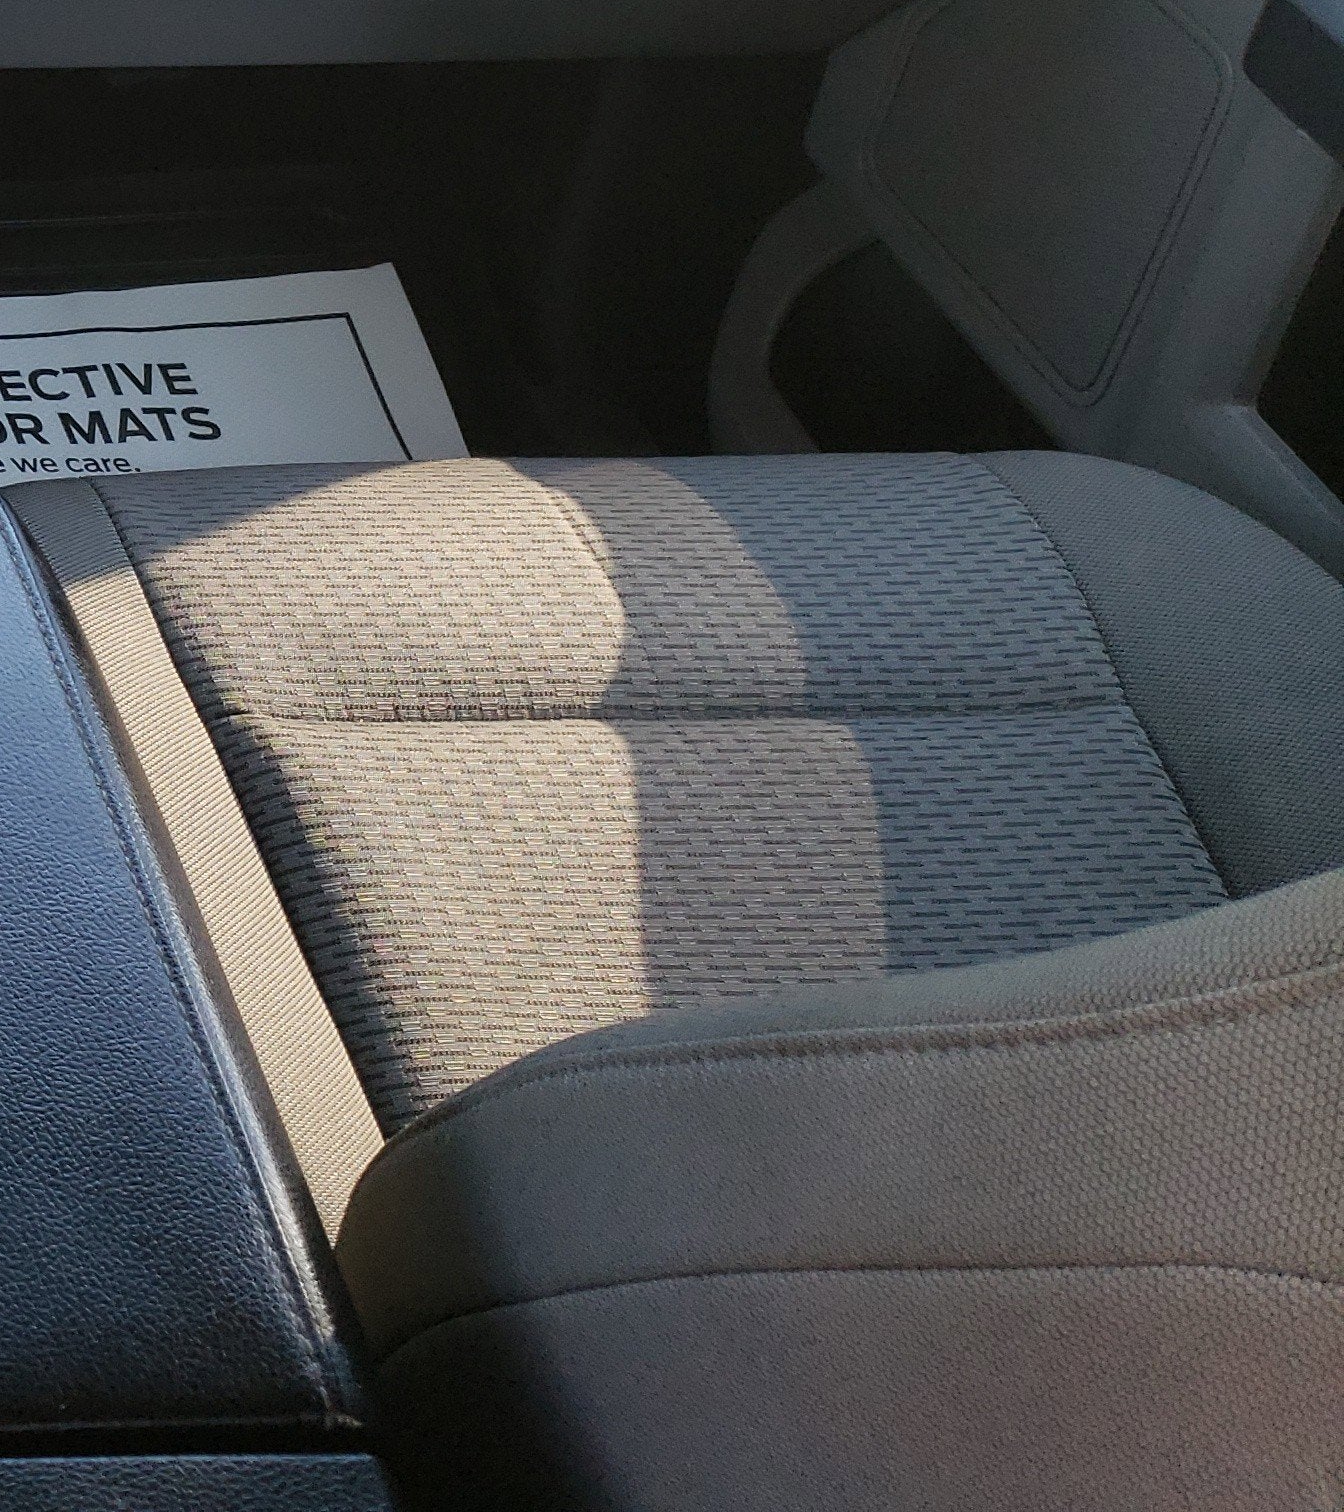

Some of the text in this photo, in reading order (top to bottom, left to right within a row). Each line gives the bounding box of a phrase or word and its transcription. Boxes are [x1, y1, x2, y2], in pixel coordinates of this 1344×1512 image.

[56, 406, 222, 445] MATS
[10, 457, 60, 473] we
[65, 457, 142, 473] care.
